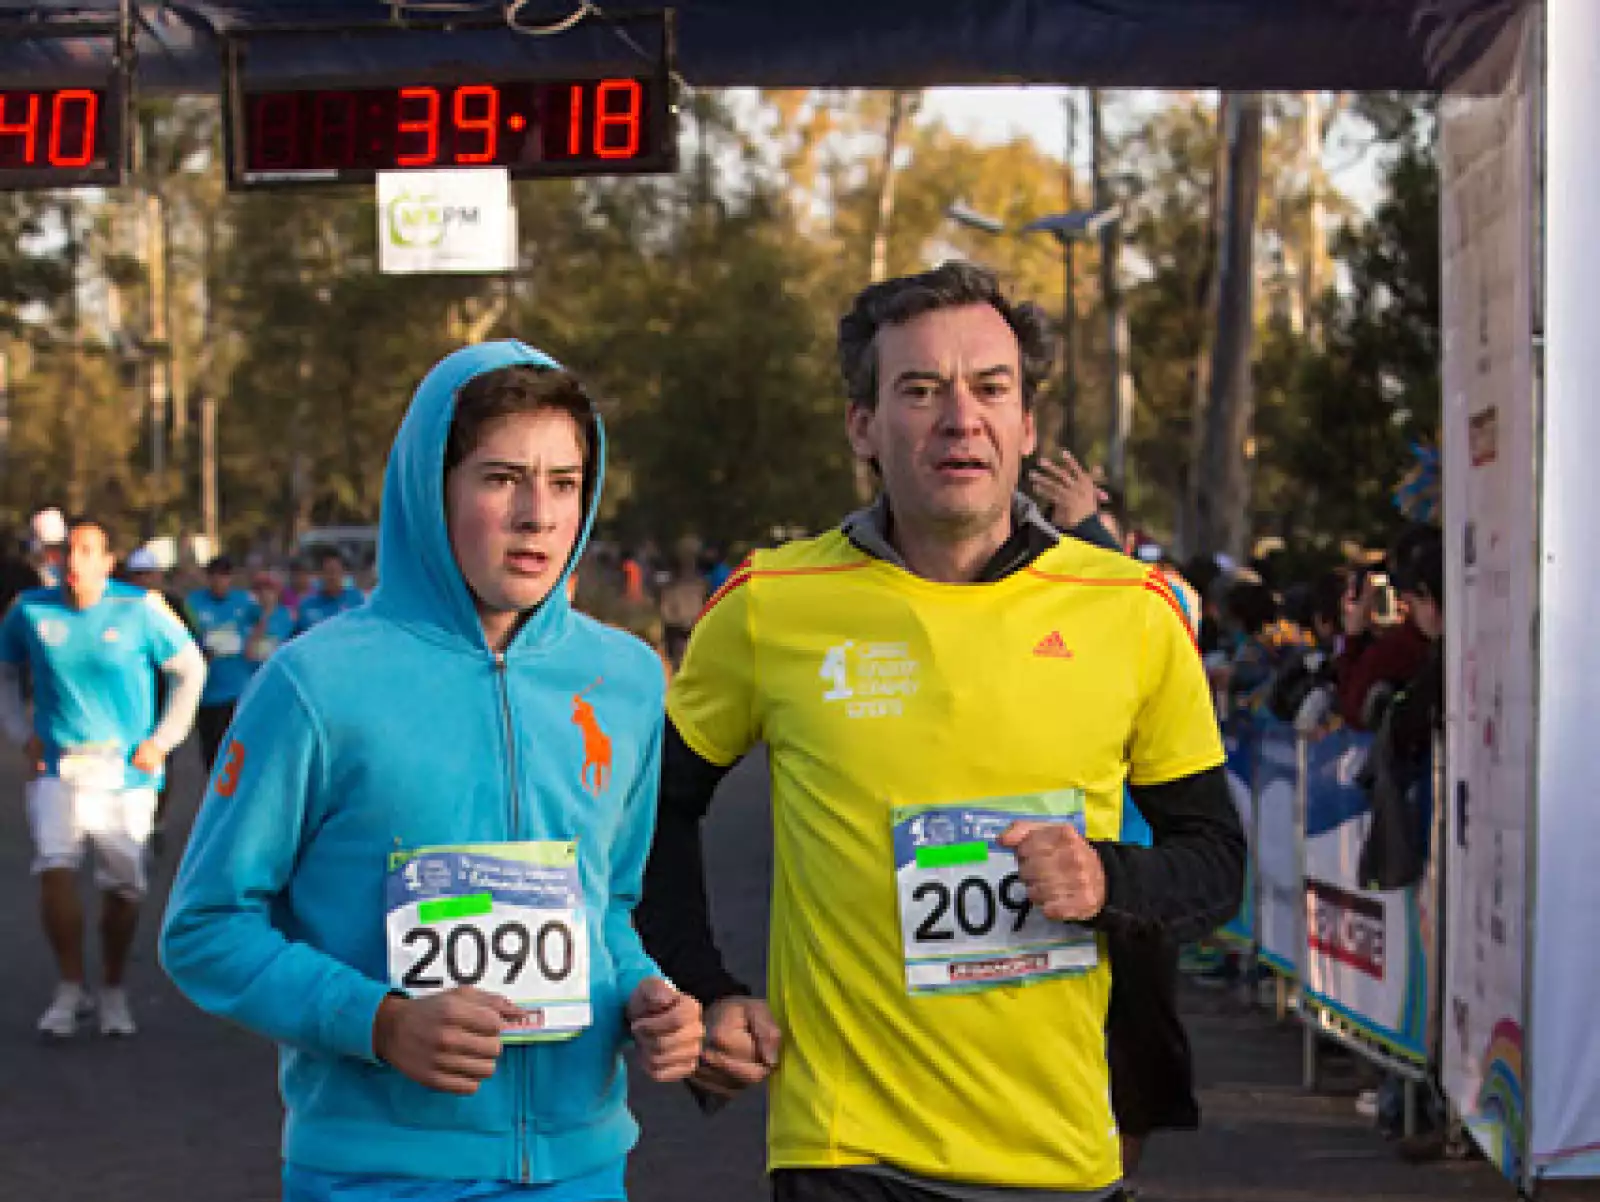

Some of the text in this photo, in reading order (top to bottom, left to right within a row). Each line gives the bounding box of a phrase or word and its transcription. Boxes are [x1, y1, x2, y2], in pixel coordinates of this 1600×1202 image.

[0, 88, 97, 167] 40
[214, 740, 245, 797] 3
[912, 871, 1033, 943] 209
[401, 920, 575, 989] 2090
